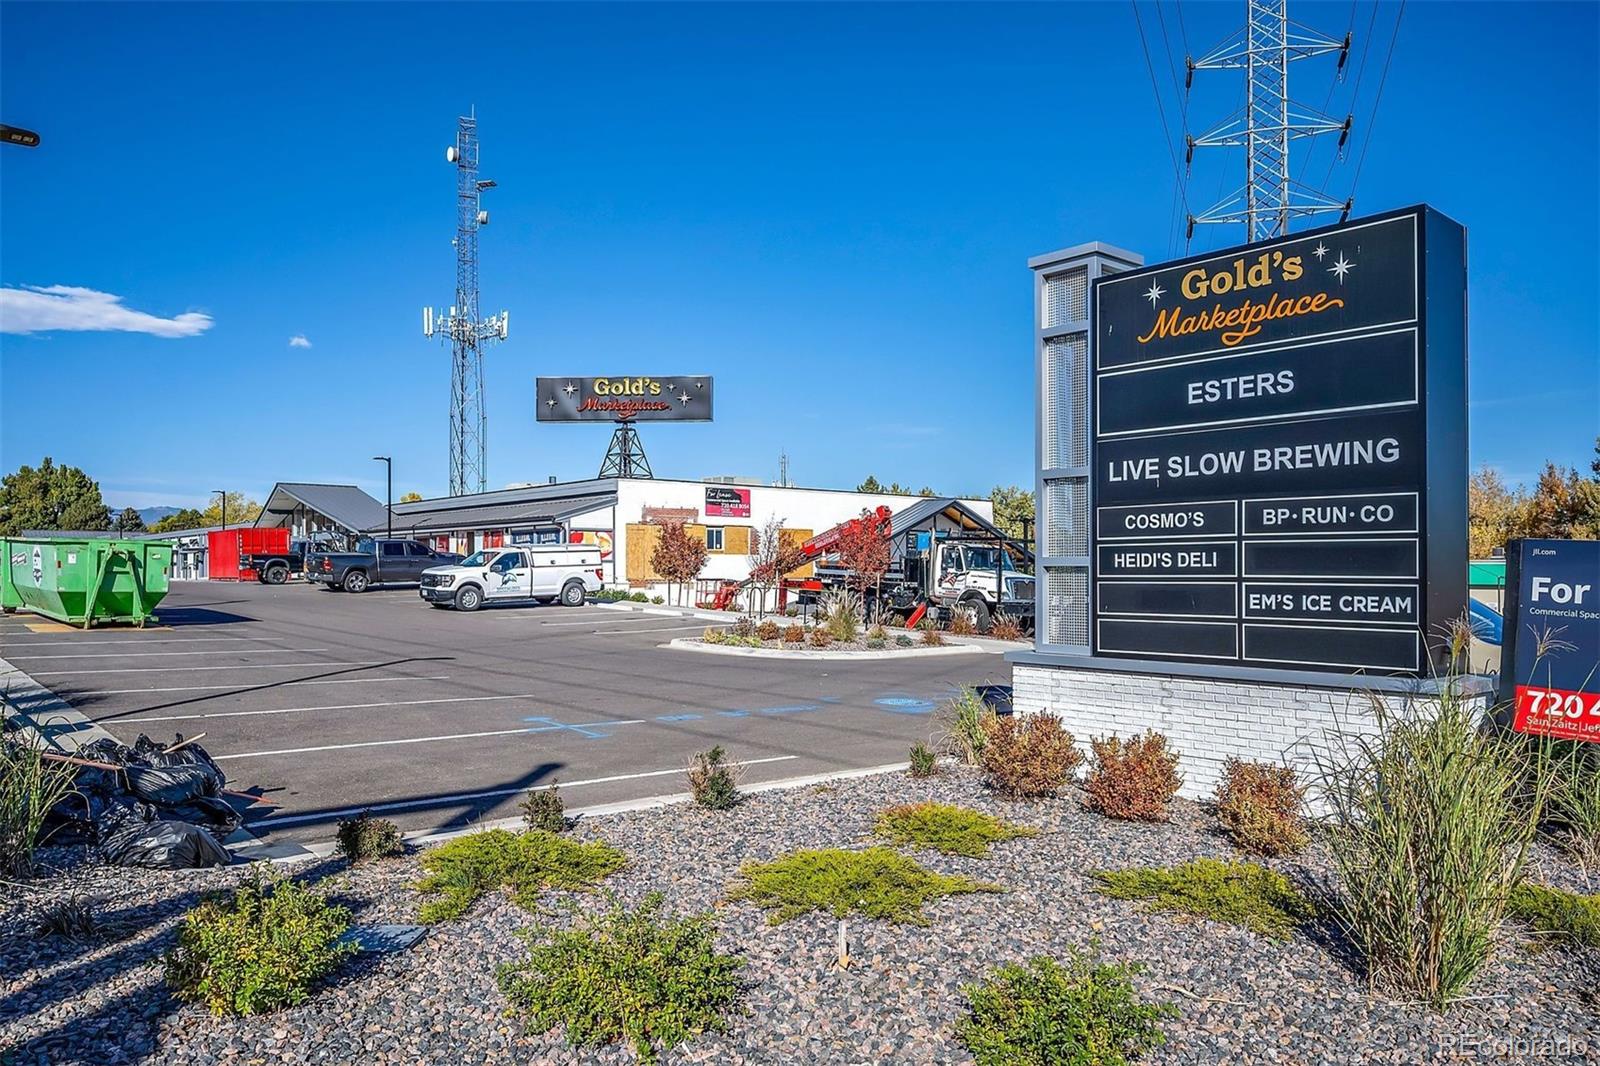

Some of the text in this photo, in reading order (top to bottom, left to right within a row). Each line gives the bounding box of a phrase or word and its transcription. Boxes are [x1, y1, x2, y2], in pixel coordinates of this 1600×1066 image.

[1181, 251, 1304, 300] Gold's
[1137, 292, 1344, 347] Marketplace
[593, 377, 662, 396] Gold's
[1188, 370, 1294, 404] ESTERS
[577, 398, 671, 419] Marketplace
[1108, 438, 1400, 482] LIVE SLOW BREWING
[1125, 511, 1204, 530] COSMO'S
[1114, 552, 1217, 568] HEIDI'S DELI
[1531, 576, 1591, 605] For
[1249, 594, 1412, 614] EM'S ICE CREAM
[1529, 607, 1578, 618] Commercial
[1527, 690, 1584, 718] 720
